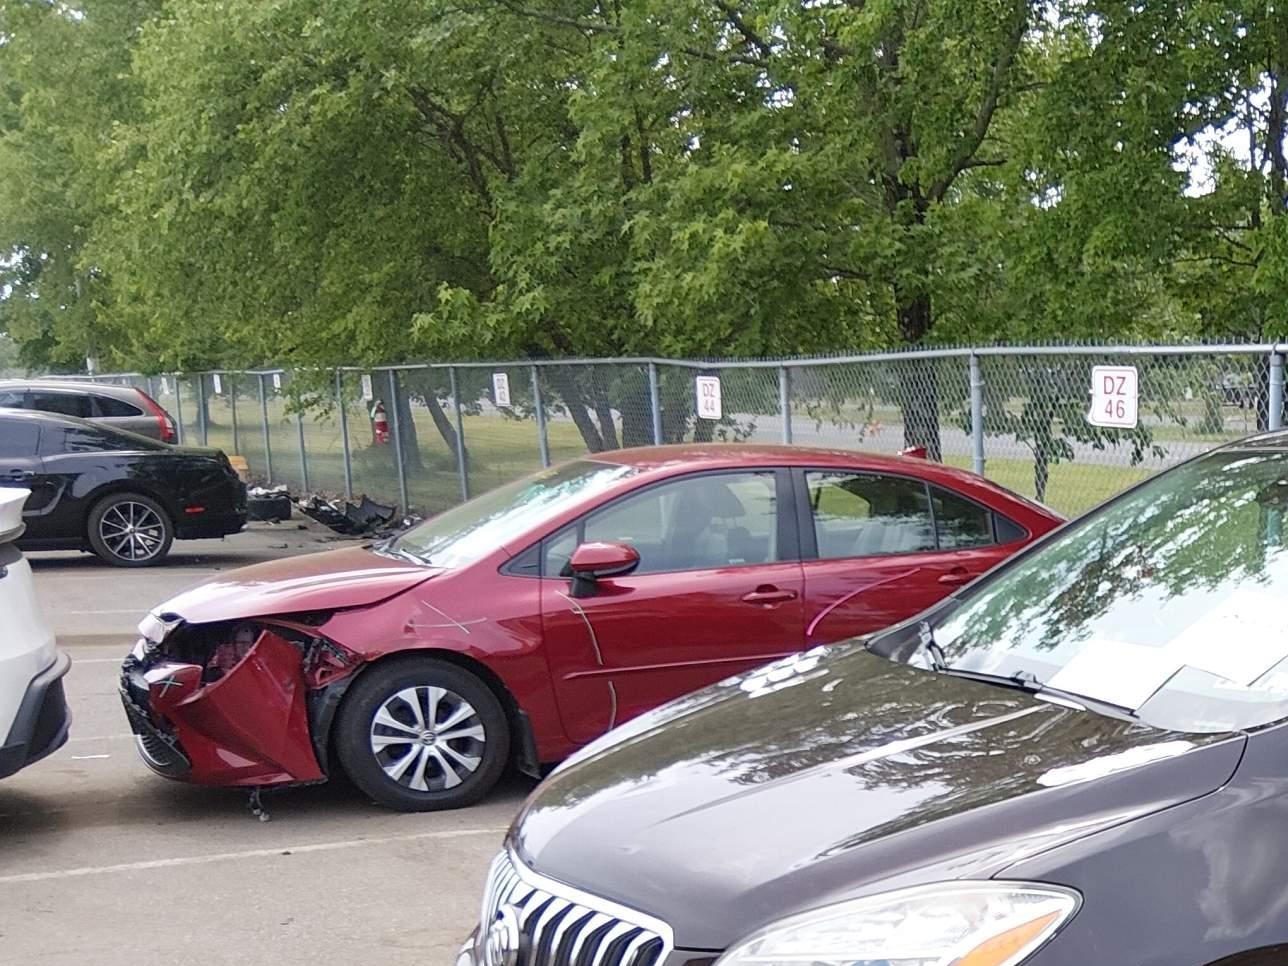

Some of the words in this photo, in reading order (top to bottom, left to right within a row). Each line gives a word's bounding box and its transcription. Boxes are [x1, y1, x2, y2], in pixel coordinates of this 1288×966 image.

[702, 383, 716, 398] DZ
[1103, 375, 1127, 396] DZ
[1104, 399, 1126, 419] 46
